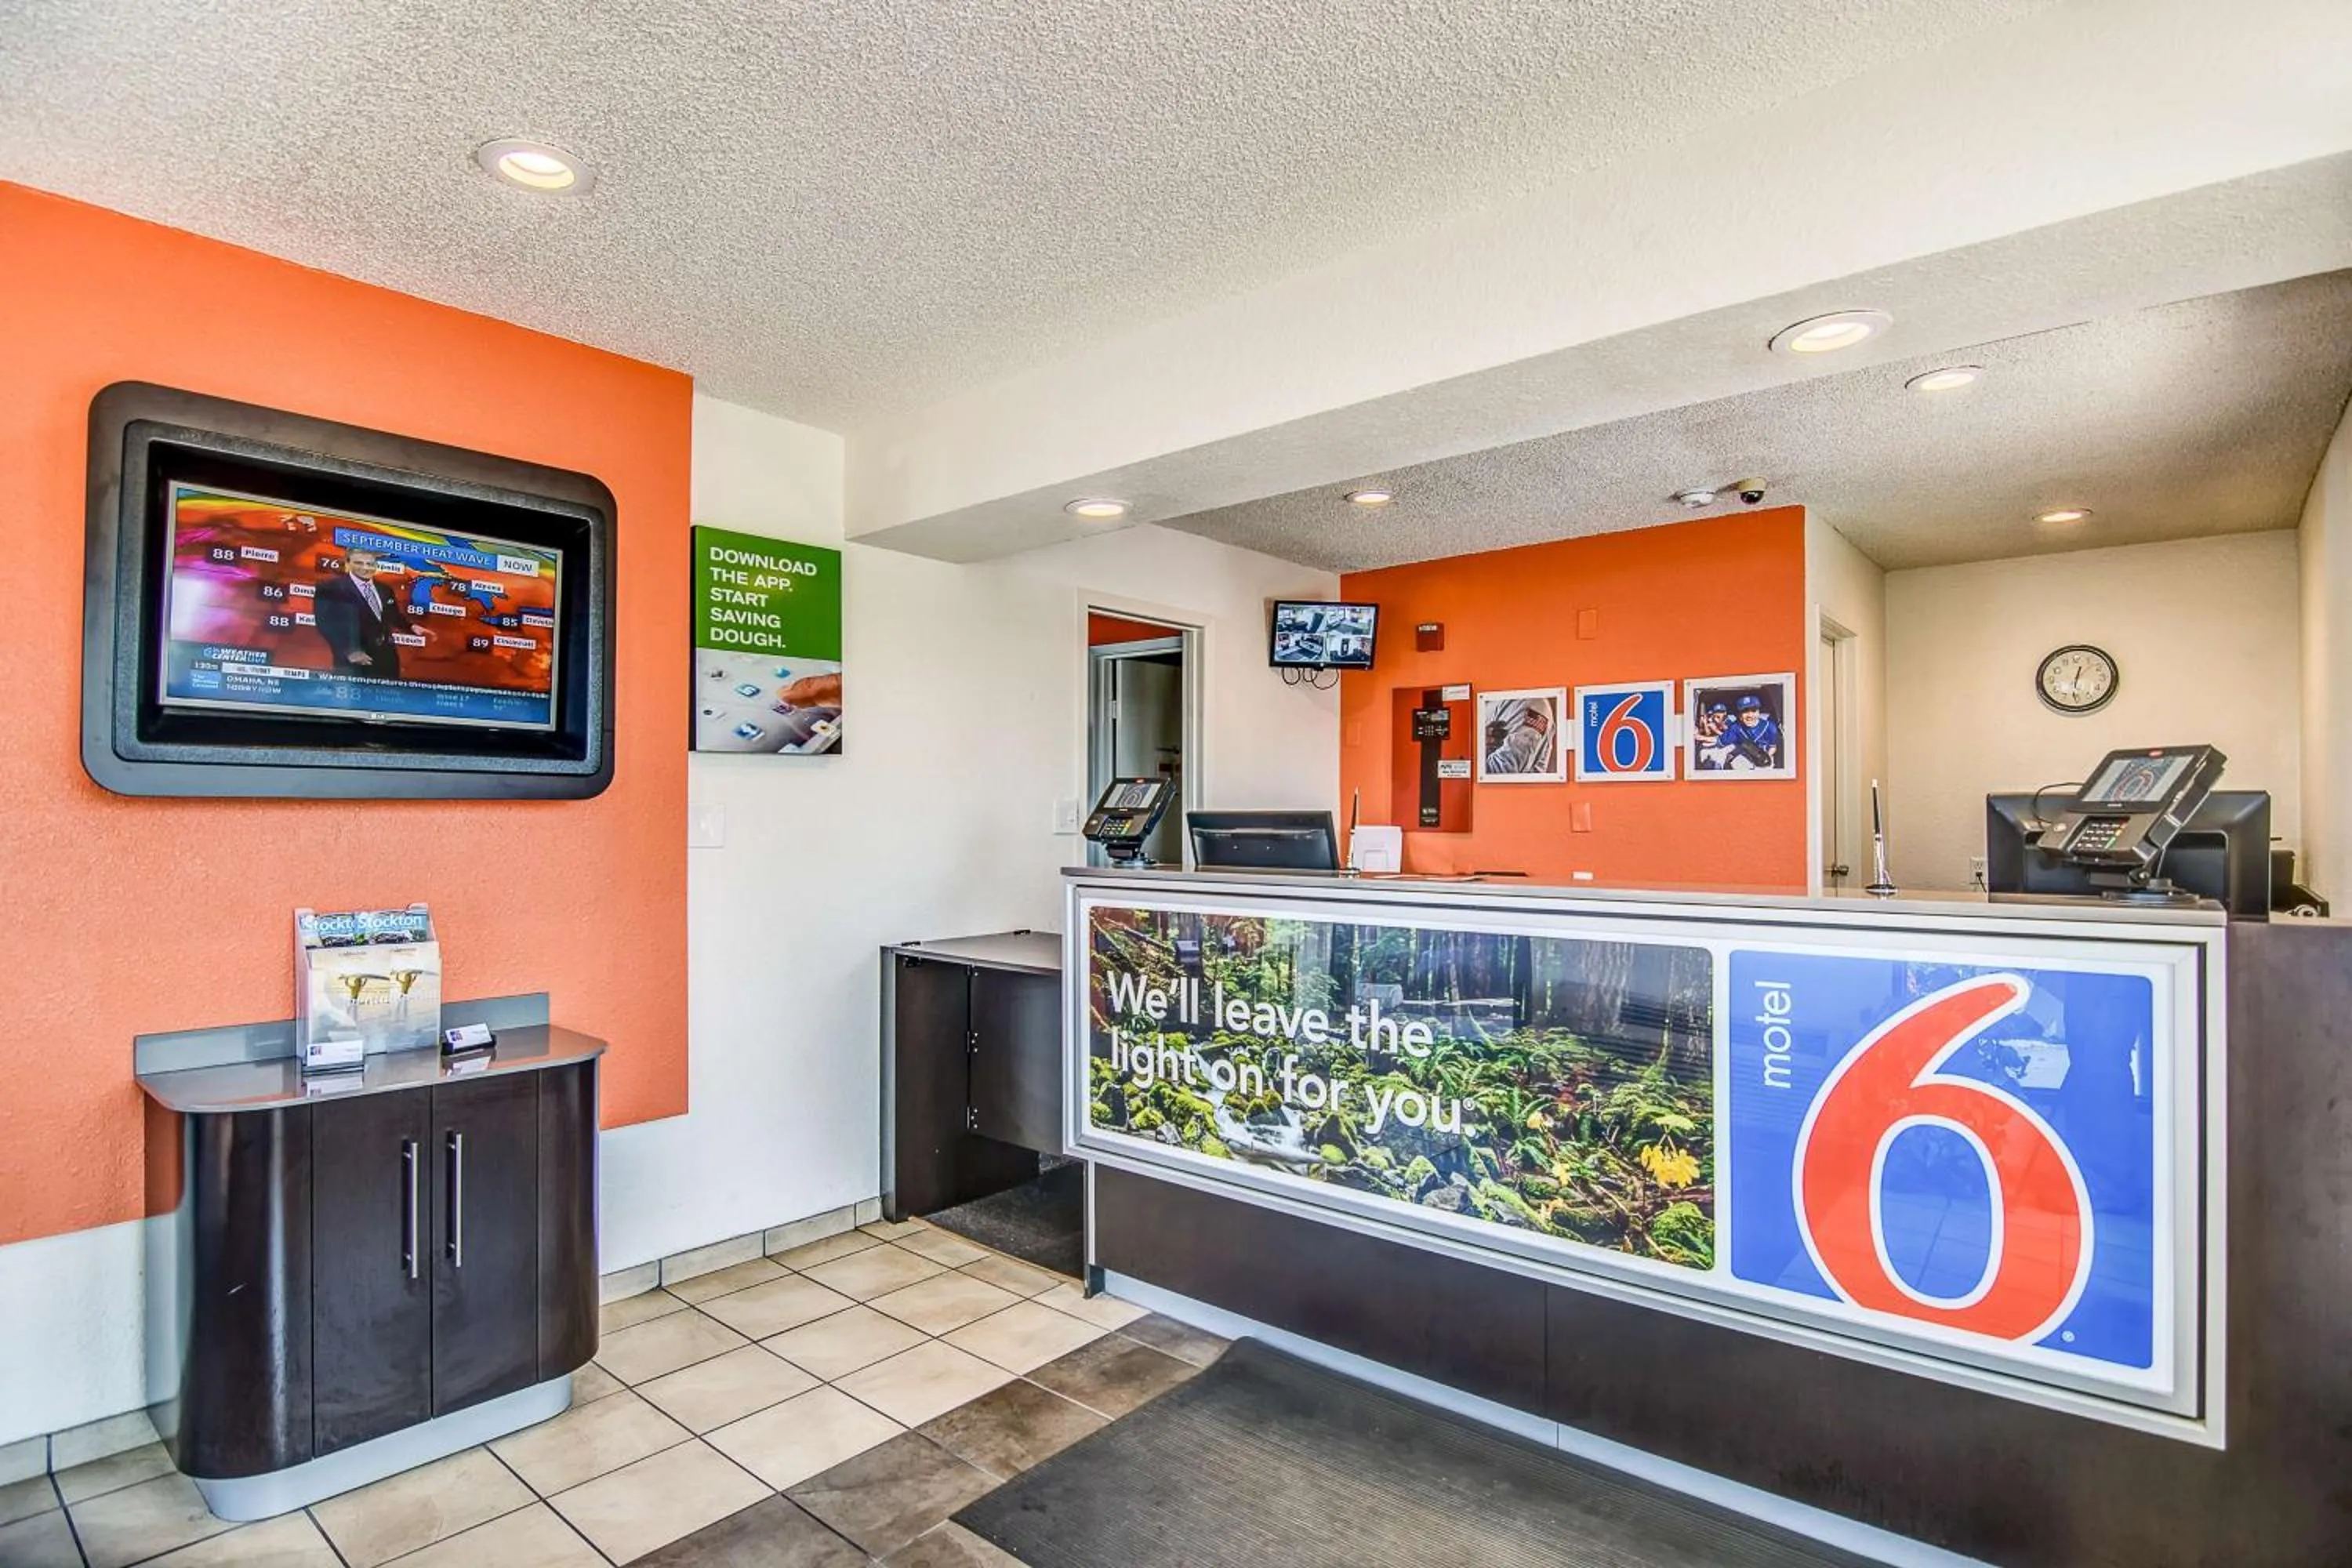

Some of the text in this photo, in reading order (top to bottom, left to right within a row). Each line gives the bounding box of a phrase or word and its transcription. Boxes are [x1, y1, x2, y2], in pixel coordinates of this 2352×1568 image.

[212, 548, 275, 561] 88 Pierre
[343, 533, 533, 572] SEPTEMBER HEAT WAVE NOW
[710, 546, 817, 576] DOWNLOAD
[321, 557, 339, 569] 76
[450, 582, 466, 592] 78
[710, 566, 793, 592] THE APP.
[263, 586, 283, 597] 86
[710, 587, 769, 607] START
[431, 604, 463, 615] Chicago
[710, 608, 781, 628] SAVING
[269, 616, 289, 626] 88
[502, 617, 518, 626] 85
[472, 637, 488, 648] 89
[710, 627, 786, 648] DOUGH.
[1588, 702, 1599, 728] motel
[1597, 693, 1654, 773] 6
[358, 913, 423, 930] Stockton
[1107, 971, 1435, 1058] We'll leave the
[1111, 1025, 1197, 1089] light
[1211, 1058, 1263, 1098] on
[1279, 1054, 1350, 1112] for
[1755, 972, 2095, 1347] motel 6
